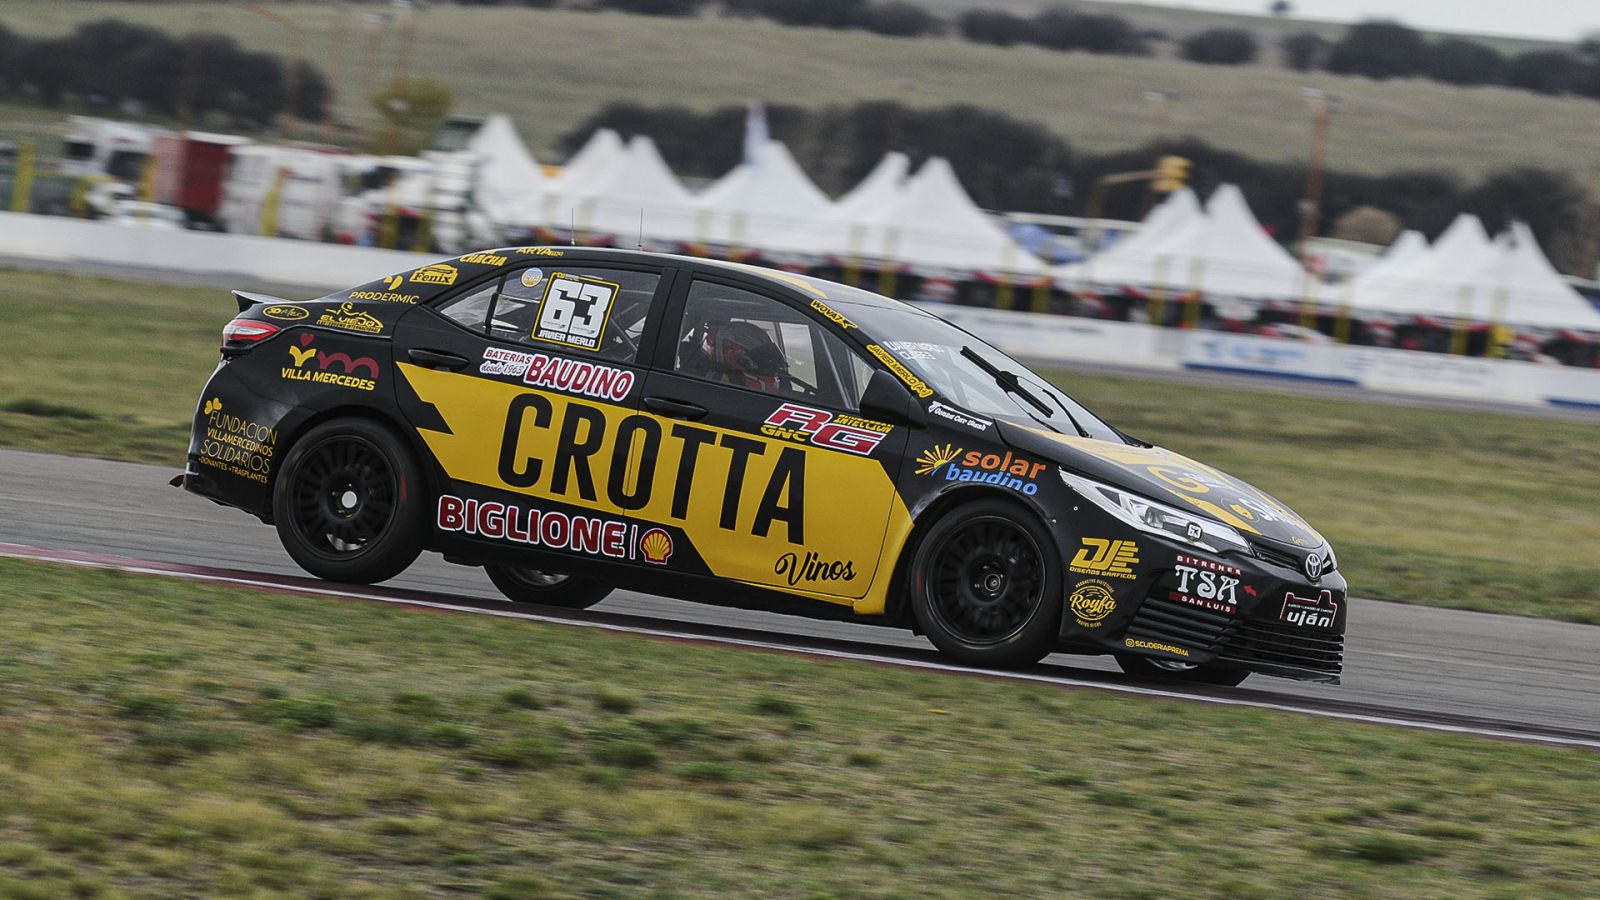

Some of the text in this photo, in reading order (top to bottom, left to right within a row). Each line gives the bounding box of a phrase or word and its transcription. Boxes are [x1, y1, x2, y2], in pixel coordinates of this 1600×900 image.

[413, 270, 453, 284] Fenix
[349, 291, 419, 305] PRODERMIC
[540, 278, 612, 339] 63
[320, 314, 335, 322] EL
[538, 330, 596, 348] JAVIER MERLO
[480, 362, 502, 374] desde
[485, 349, 634, 400] BATERIAS BAUDINO
[867, 345, 893, 365] JAVIER
[892, 363, 917, 385] MERLO
[281, 367, 376, 392] VILLA MERCEDES
[208, 411, 277, 446] FUNDACION
[760, 424, 810, 442] GNC
[207, 428, 274, 457] VILLAMERCEDINOS
[200, 439, 271, 474] SOLIDARIOS
[498, 393, 808, 546] CROTTA
[962, 451, 1047, 479] solar
[945, 463, 1038, 496] baudino
[437, 495, 626, 559] BIGLIONE
[775, 552, 857, 586] Vinos
[1177, 555, 1242, 575] BITRENES
[1175, 564, 1239, 605] TSA
[1069, 593, 1117, 614] Royfa
[1181, 595, 1231, 613] SAN LUIS
[1286, 610, 1332, 628] uján
[1135, 640, 1190, 657] SCUDERIAPREMA
